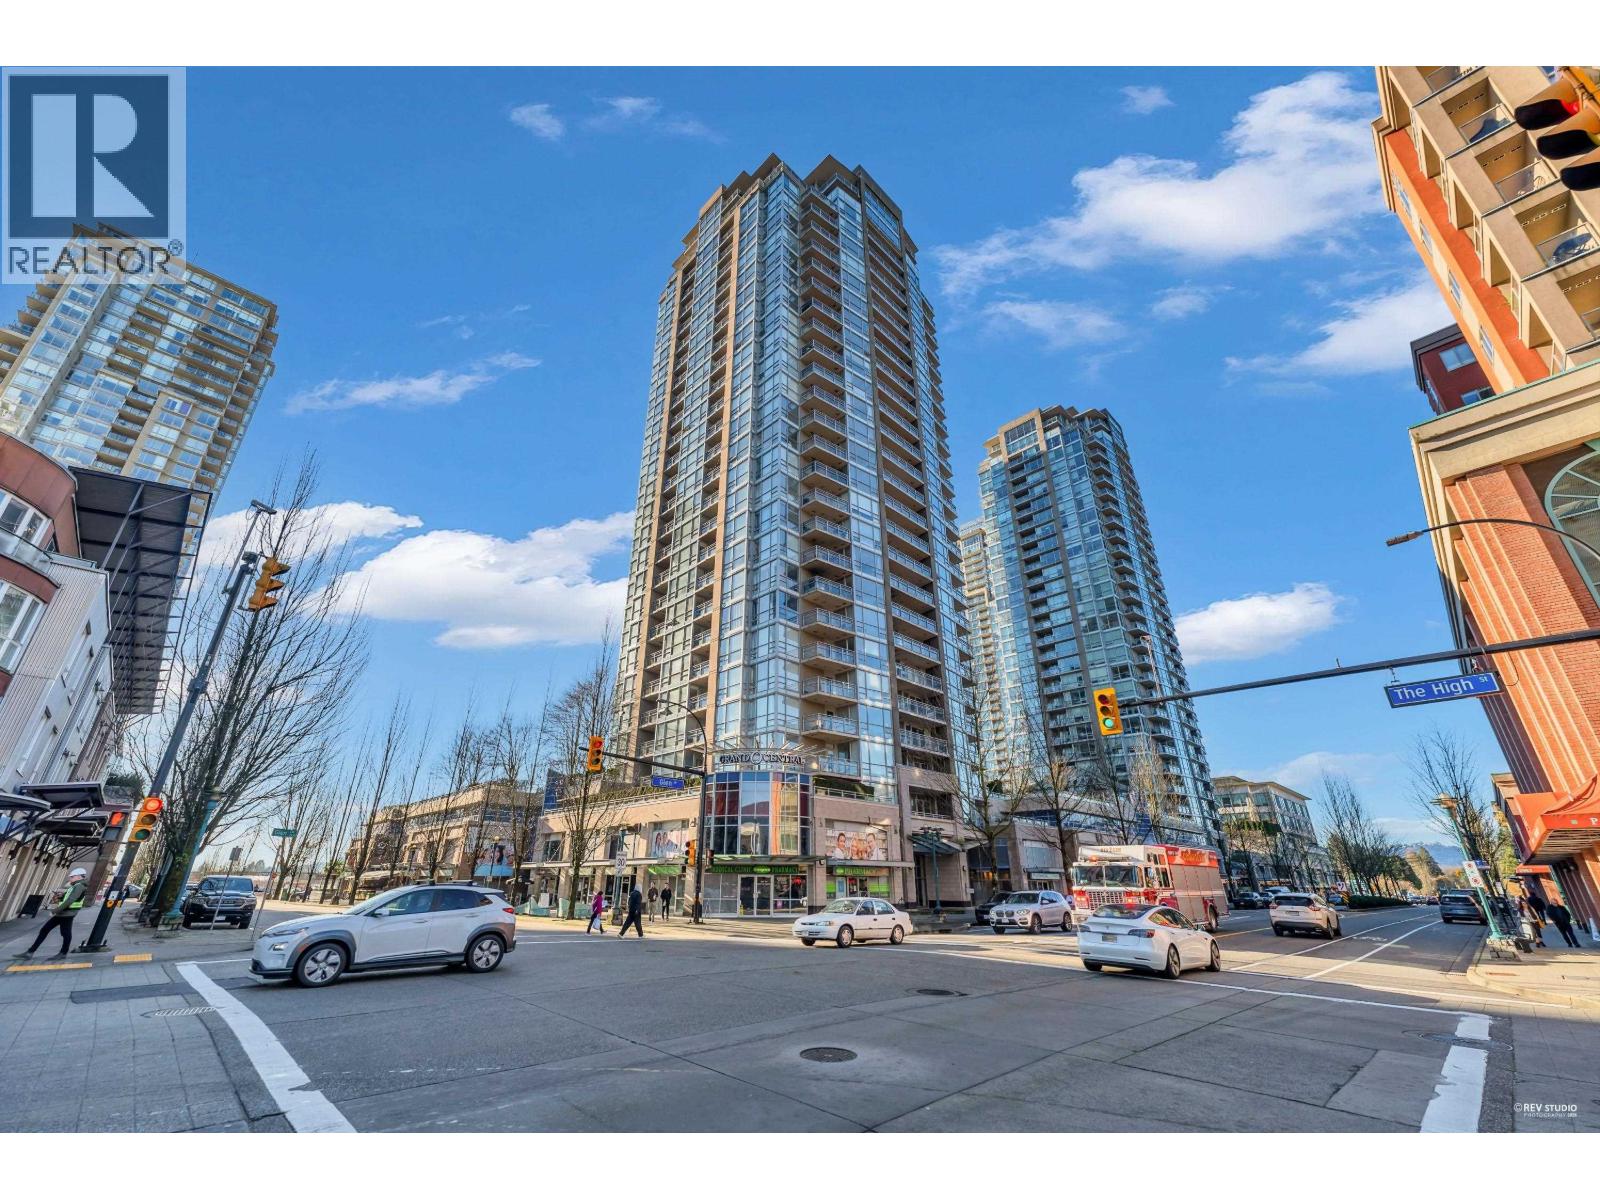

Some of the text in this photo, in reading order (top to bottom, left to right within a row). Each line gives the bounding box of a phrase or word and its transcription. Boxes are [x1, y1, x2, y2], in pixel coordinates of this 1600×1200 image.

[1394, 687, 1426, 700] The
[1431, 679, 1474, 695] High
[719, 753, 750, 765] GRAND
[761, 753, 805, 765] CENTRAL
